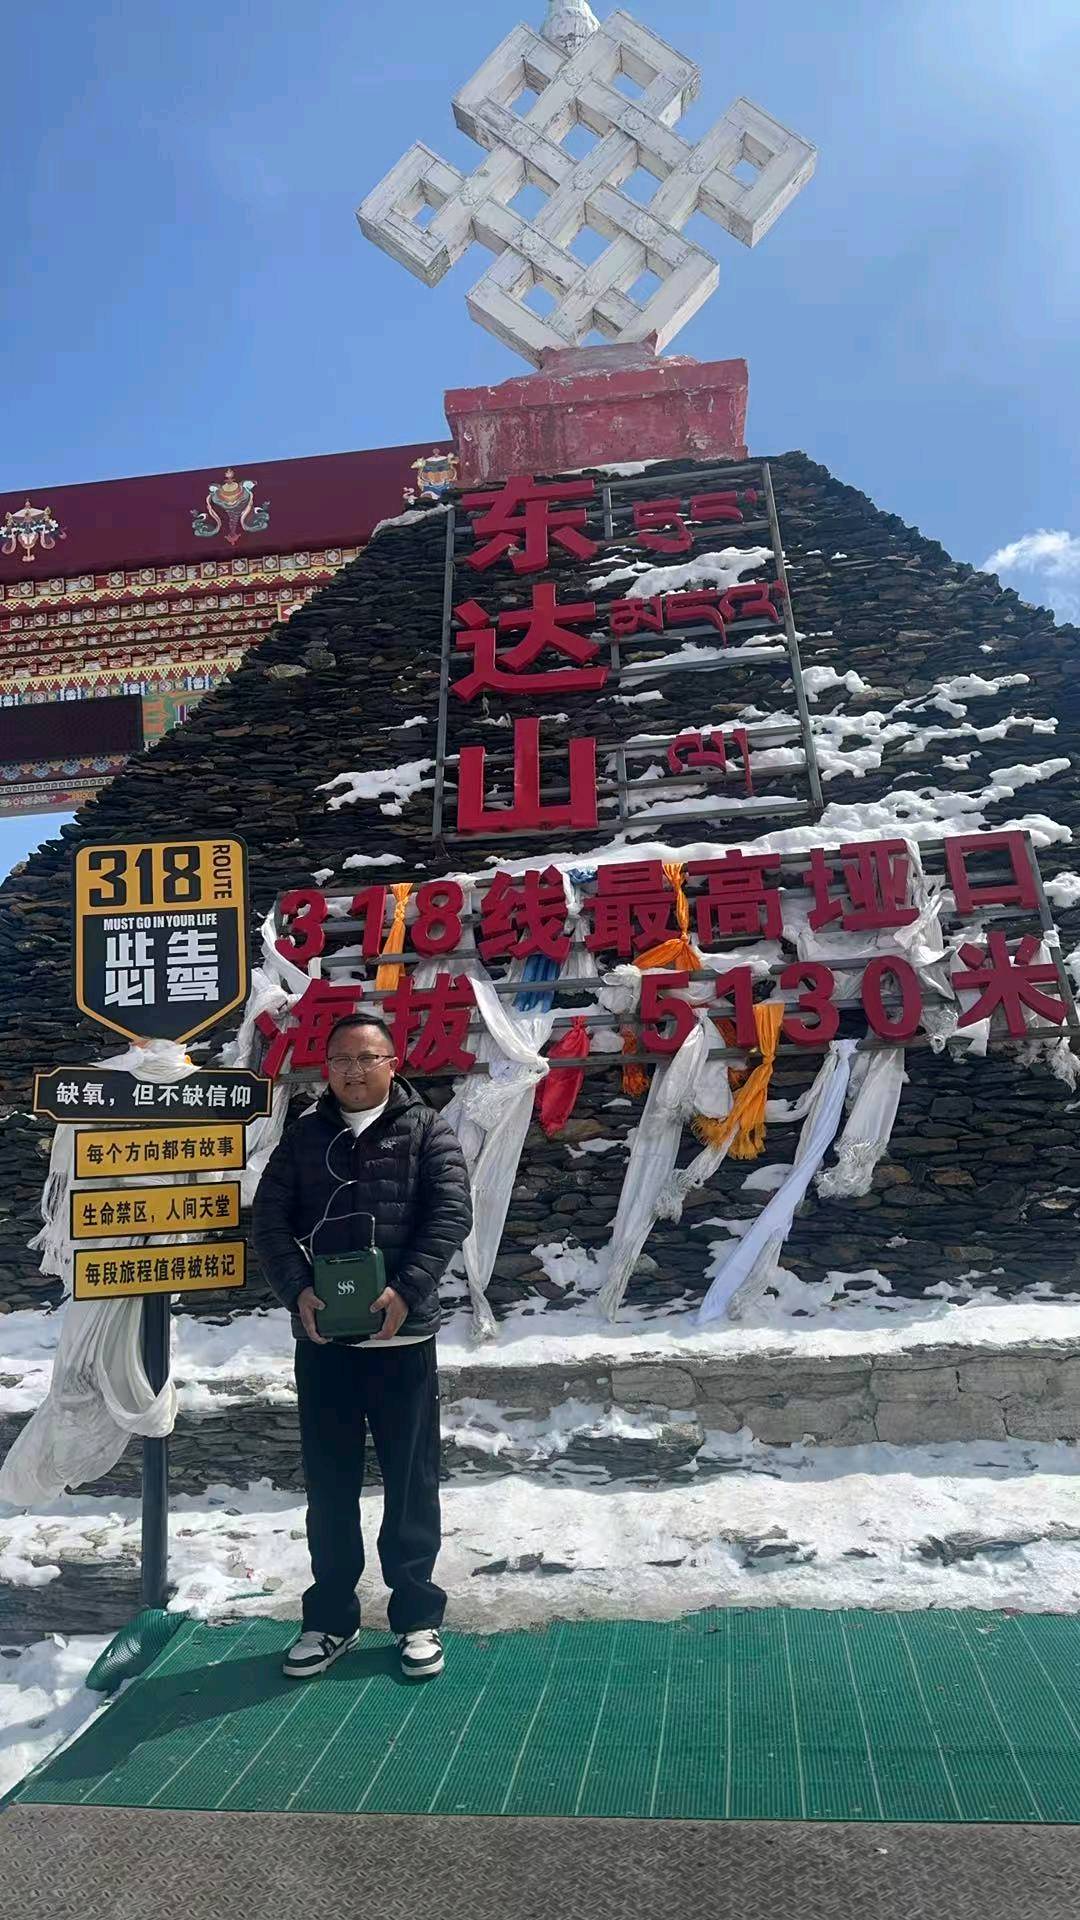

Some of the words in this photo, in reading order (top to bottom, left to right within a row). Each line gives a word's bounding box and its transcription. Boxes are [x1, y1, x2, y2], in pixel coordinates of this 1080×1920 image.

[449, 475, 610, 832] 东达山
[89, 846, 202, 907] 318
[212, 844, 232, 899] ROUTE
[275, 830, 1040, 964] 318线最高垭口
[103, 917, 134, 931] MUST
[136, 916, 151, 929] GO
[153, 915, 165, 928] IN
[166, 914, 195, 927] YOUR
[196, 913, 218, 926] LIFE
[105, 929, 218, 968] 此生
[104, 966, 219, 1007] 必驾
[254, 972, 478, 1082] 海拔
[638, 930, 1069, 1056] 5130米
[56, 1081, 251, 1108] 缺氧，但不缺信仰
[86, 1135, 235, 1165] 每个方向都有故事
[82, 1194, 231, 1227] 生命禁区，人间天堂
[85, 1254, 236, 1287] 每段旅程值得被铭记
